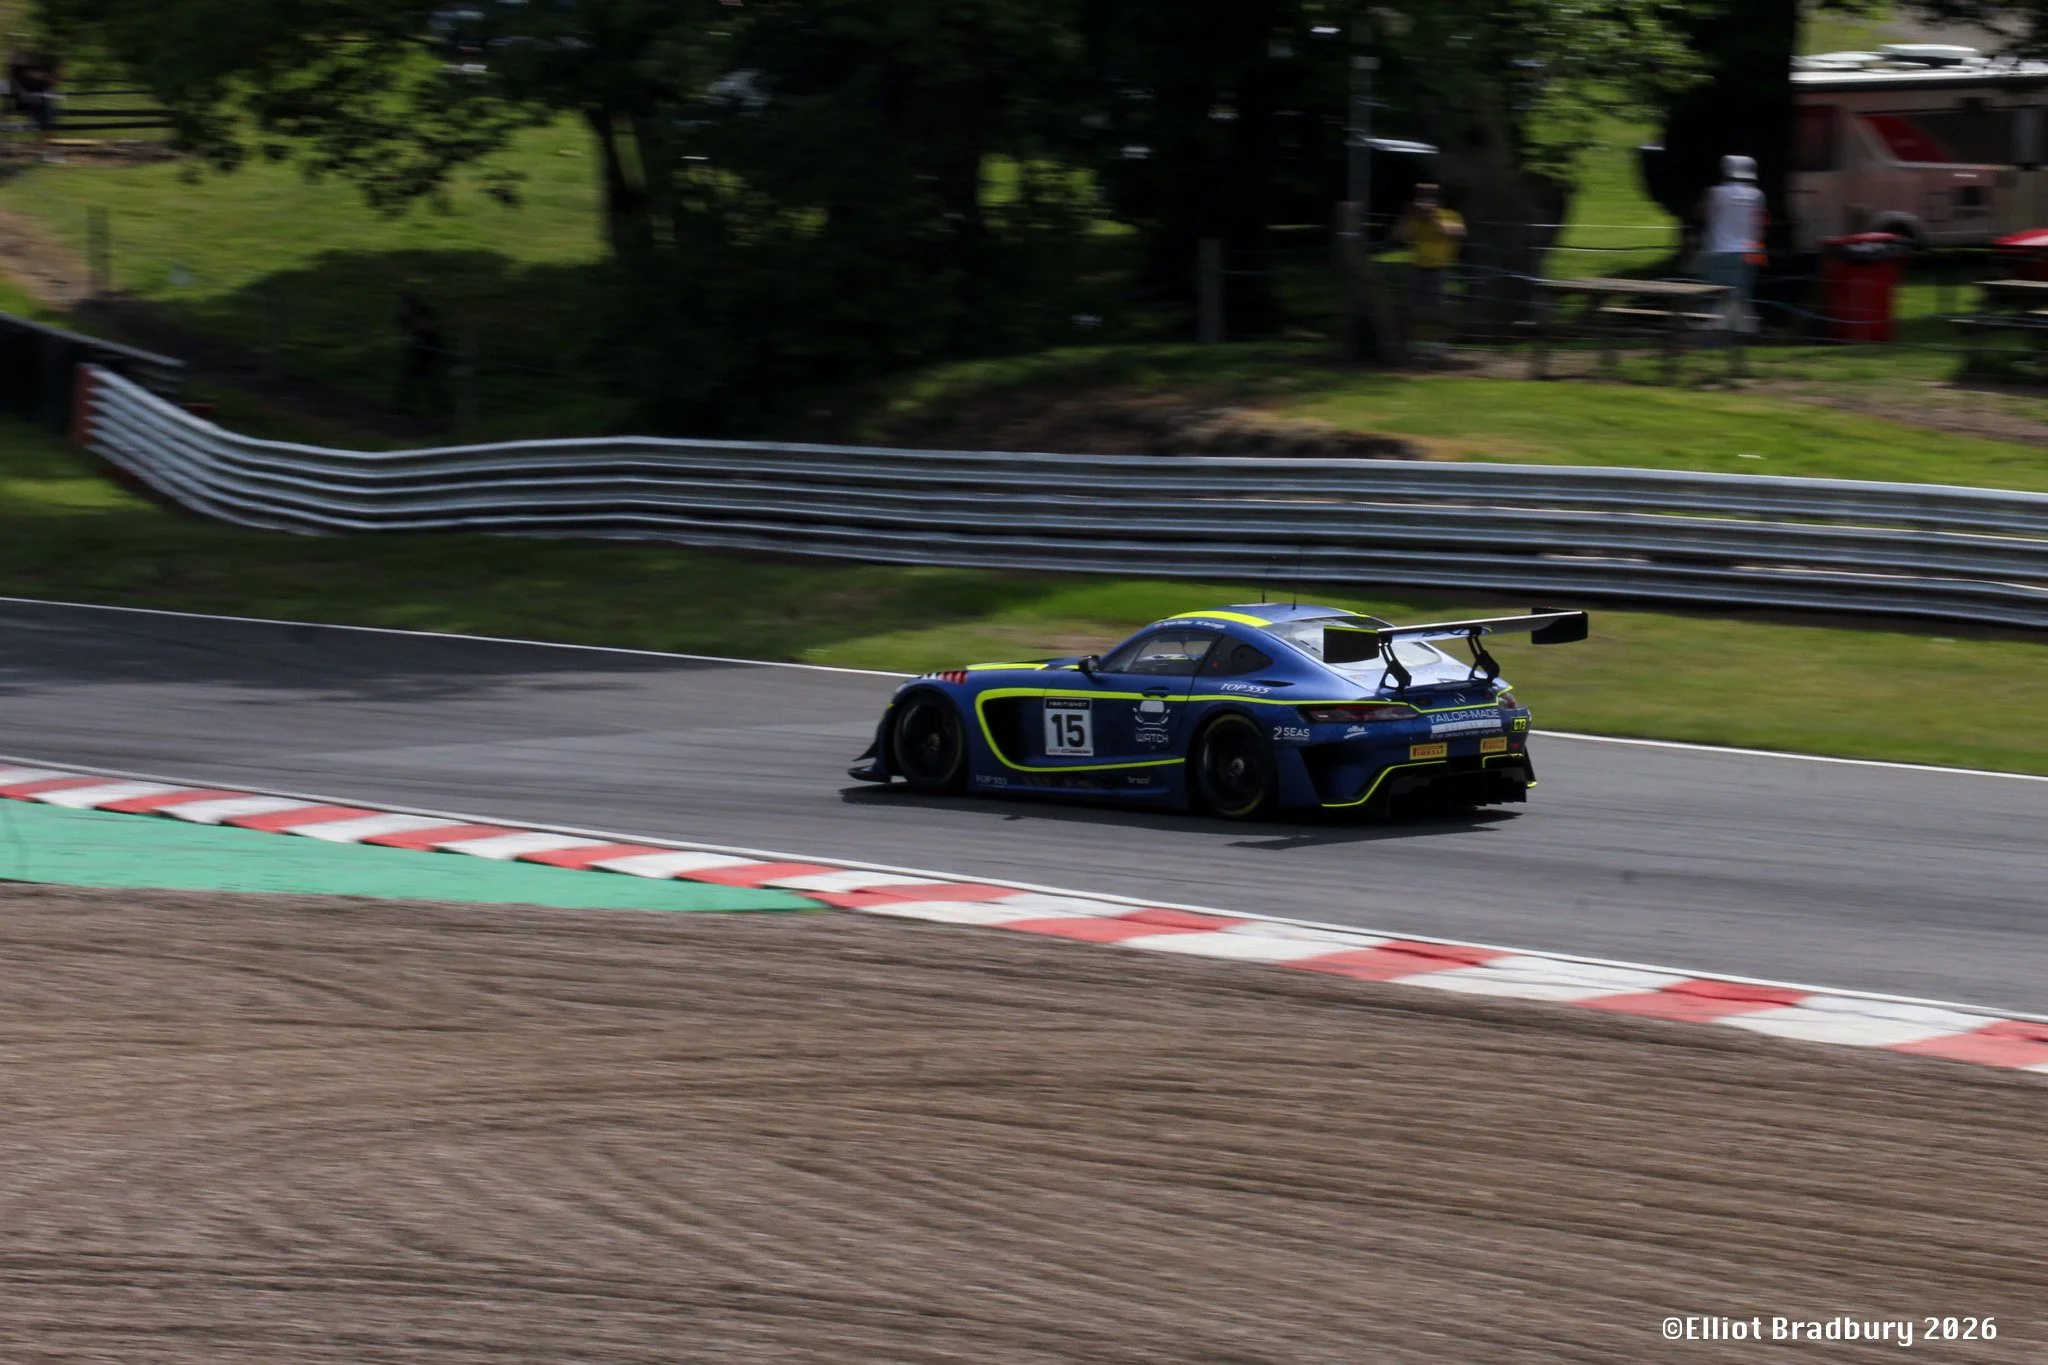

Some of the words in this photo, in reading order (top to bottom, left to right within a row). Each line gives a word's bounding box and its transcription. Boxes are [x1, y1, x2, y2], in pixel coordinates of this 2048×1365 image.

[1427, 709, 1499, 724] TAILOR-MADE
[1051, 714, 1085, 747] 15
[1513, 719, 1527, 730] GT3
[1135, 733, 1169, 743] WATCH
[1273, 726, 1282, 740] 2
[1284, 727, 1310, 737] SEAS
[1413, 745, 1444, 757] PIRELLI
